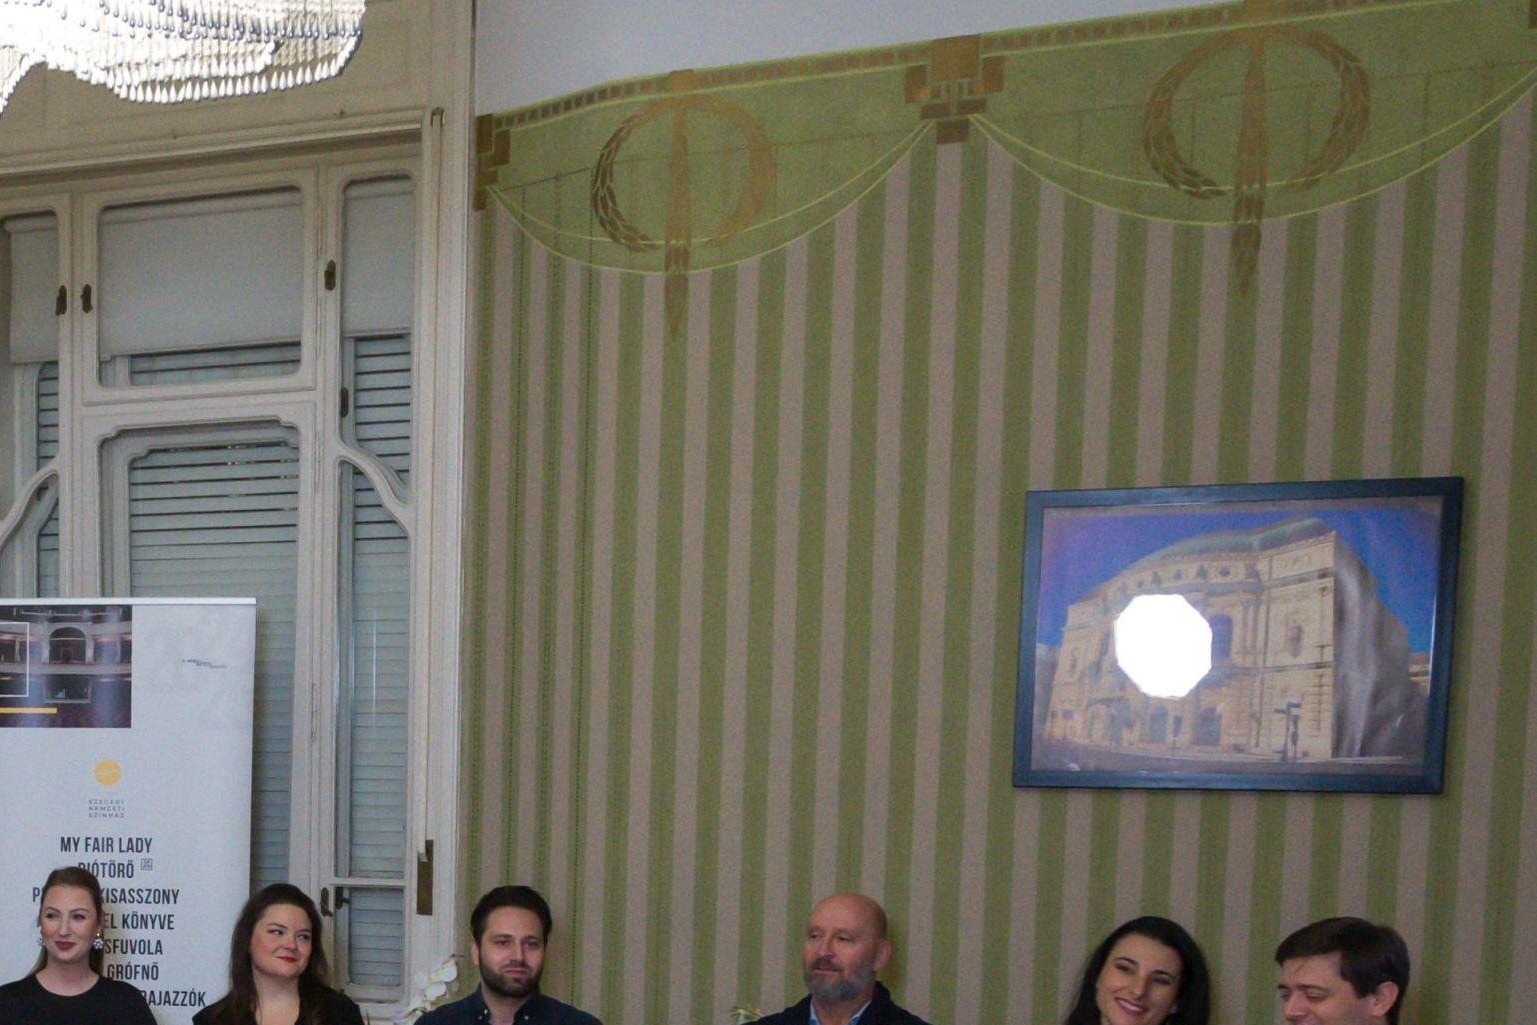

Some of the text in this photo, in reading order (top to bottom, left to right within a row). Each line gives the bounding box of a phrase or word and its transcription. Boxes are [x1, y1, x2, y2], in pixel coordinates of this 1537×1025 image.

[60, 836, 153, 854] MY FAIR LADY
[121, 912, 175, 930] KÖNYVE
[107, 961, 159, 981] GRÓFNŐ
